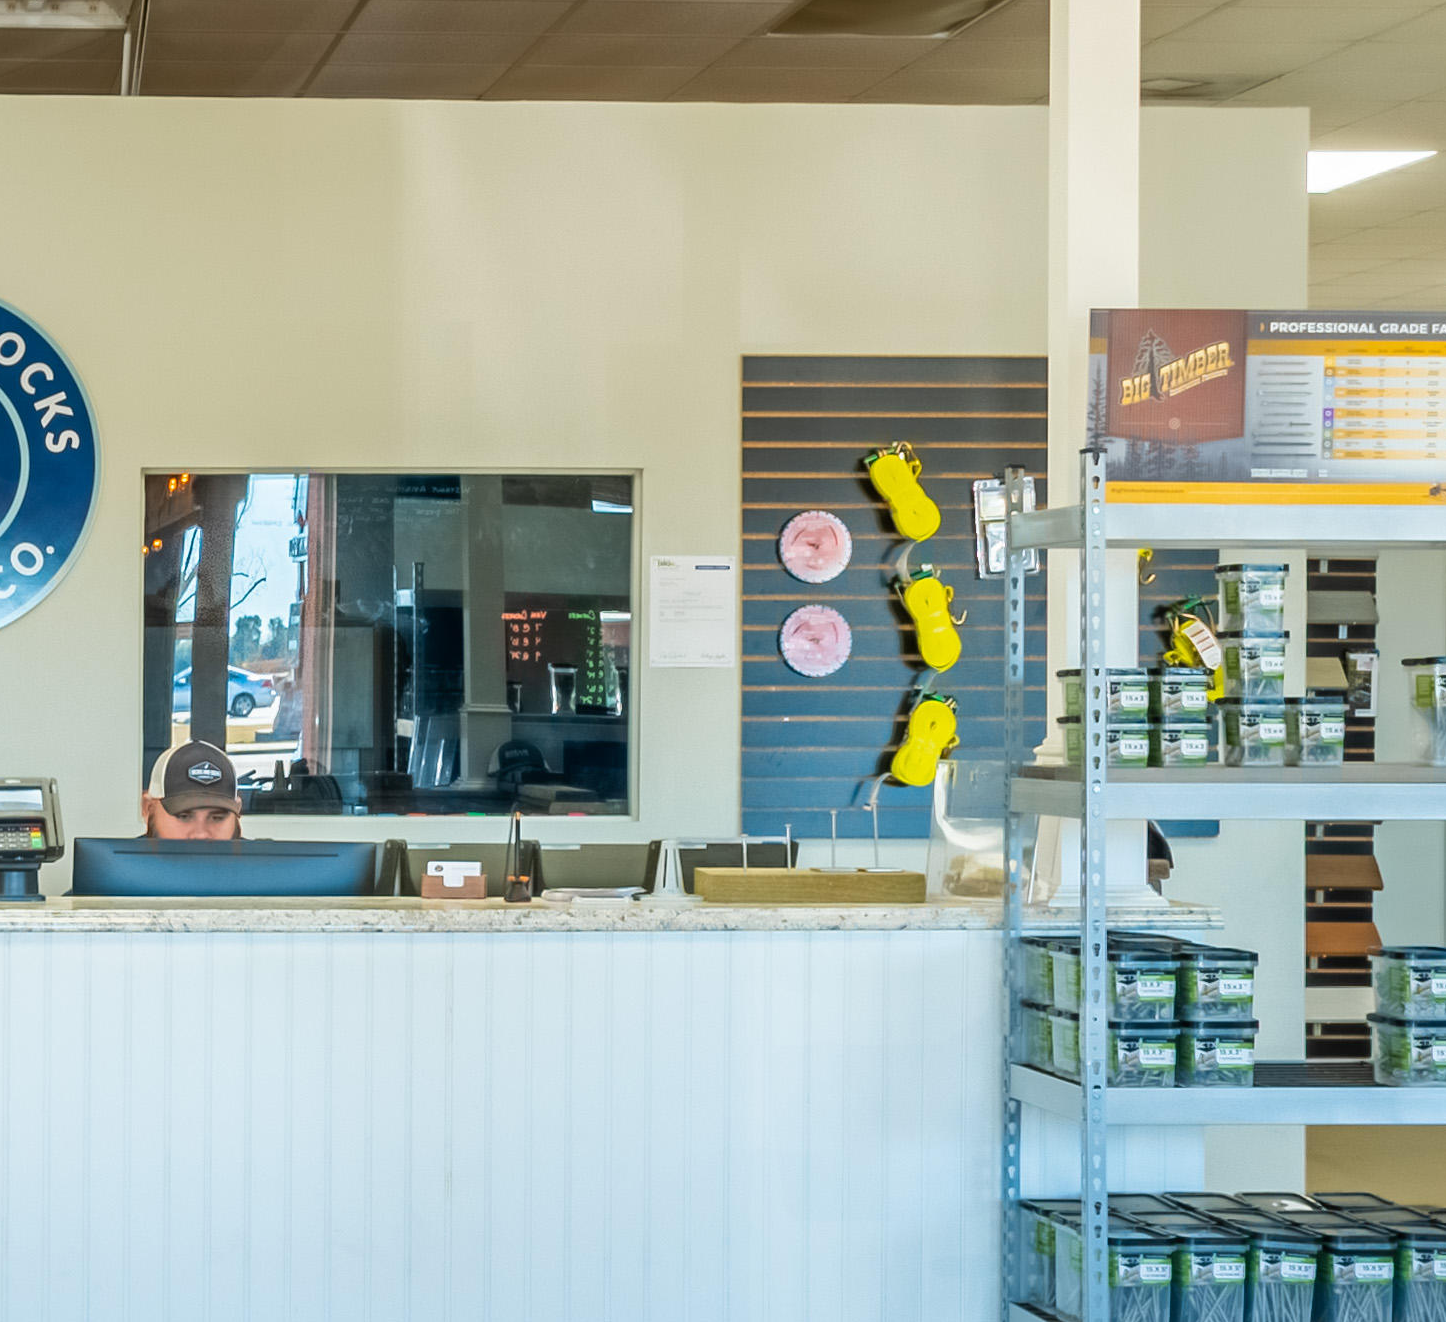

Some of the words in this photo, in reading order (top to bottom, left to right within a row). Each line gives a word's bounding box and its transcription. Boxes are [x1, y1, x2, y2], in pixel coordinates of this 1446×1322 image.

[1269, 322, 1377, 335] PROFESSIONAL
[1379, 323, 1428, 335] GRADE
[1120, 373, 1151, 406] BIG
[1159, 341, 1235, 393] TIMBER
